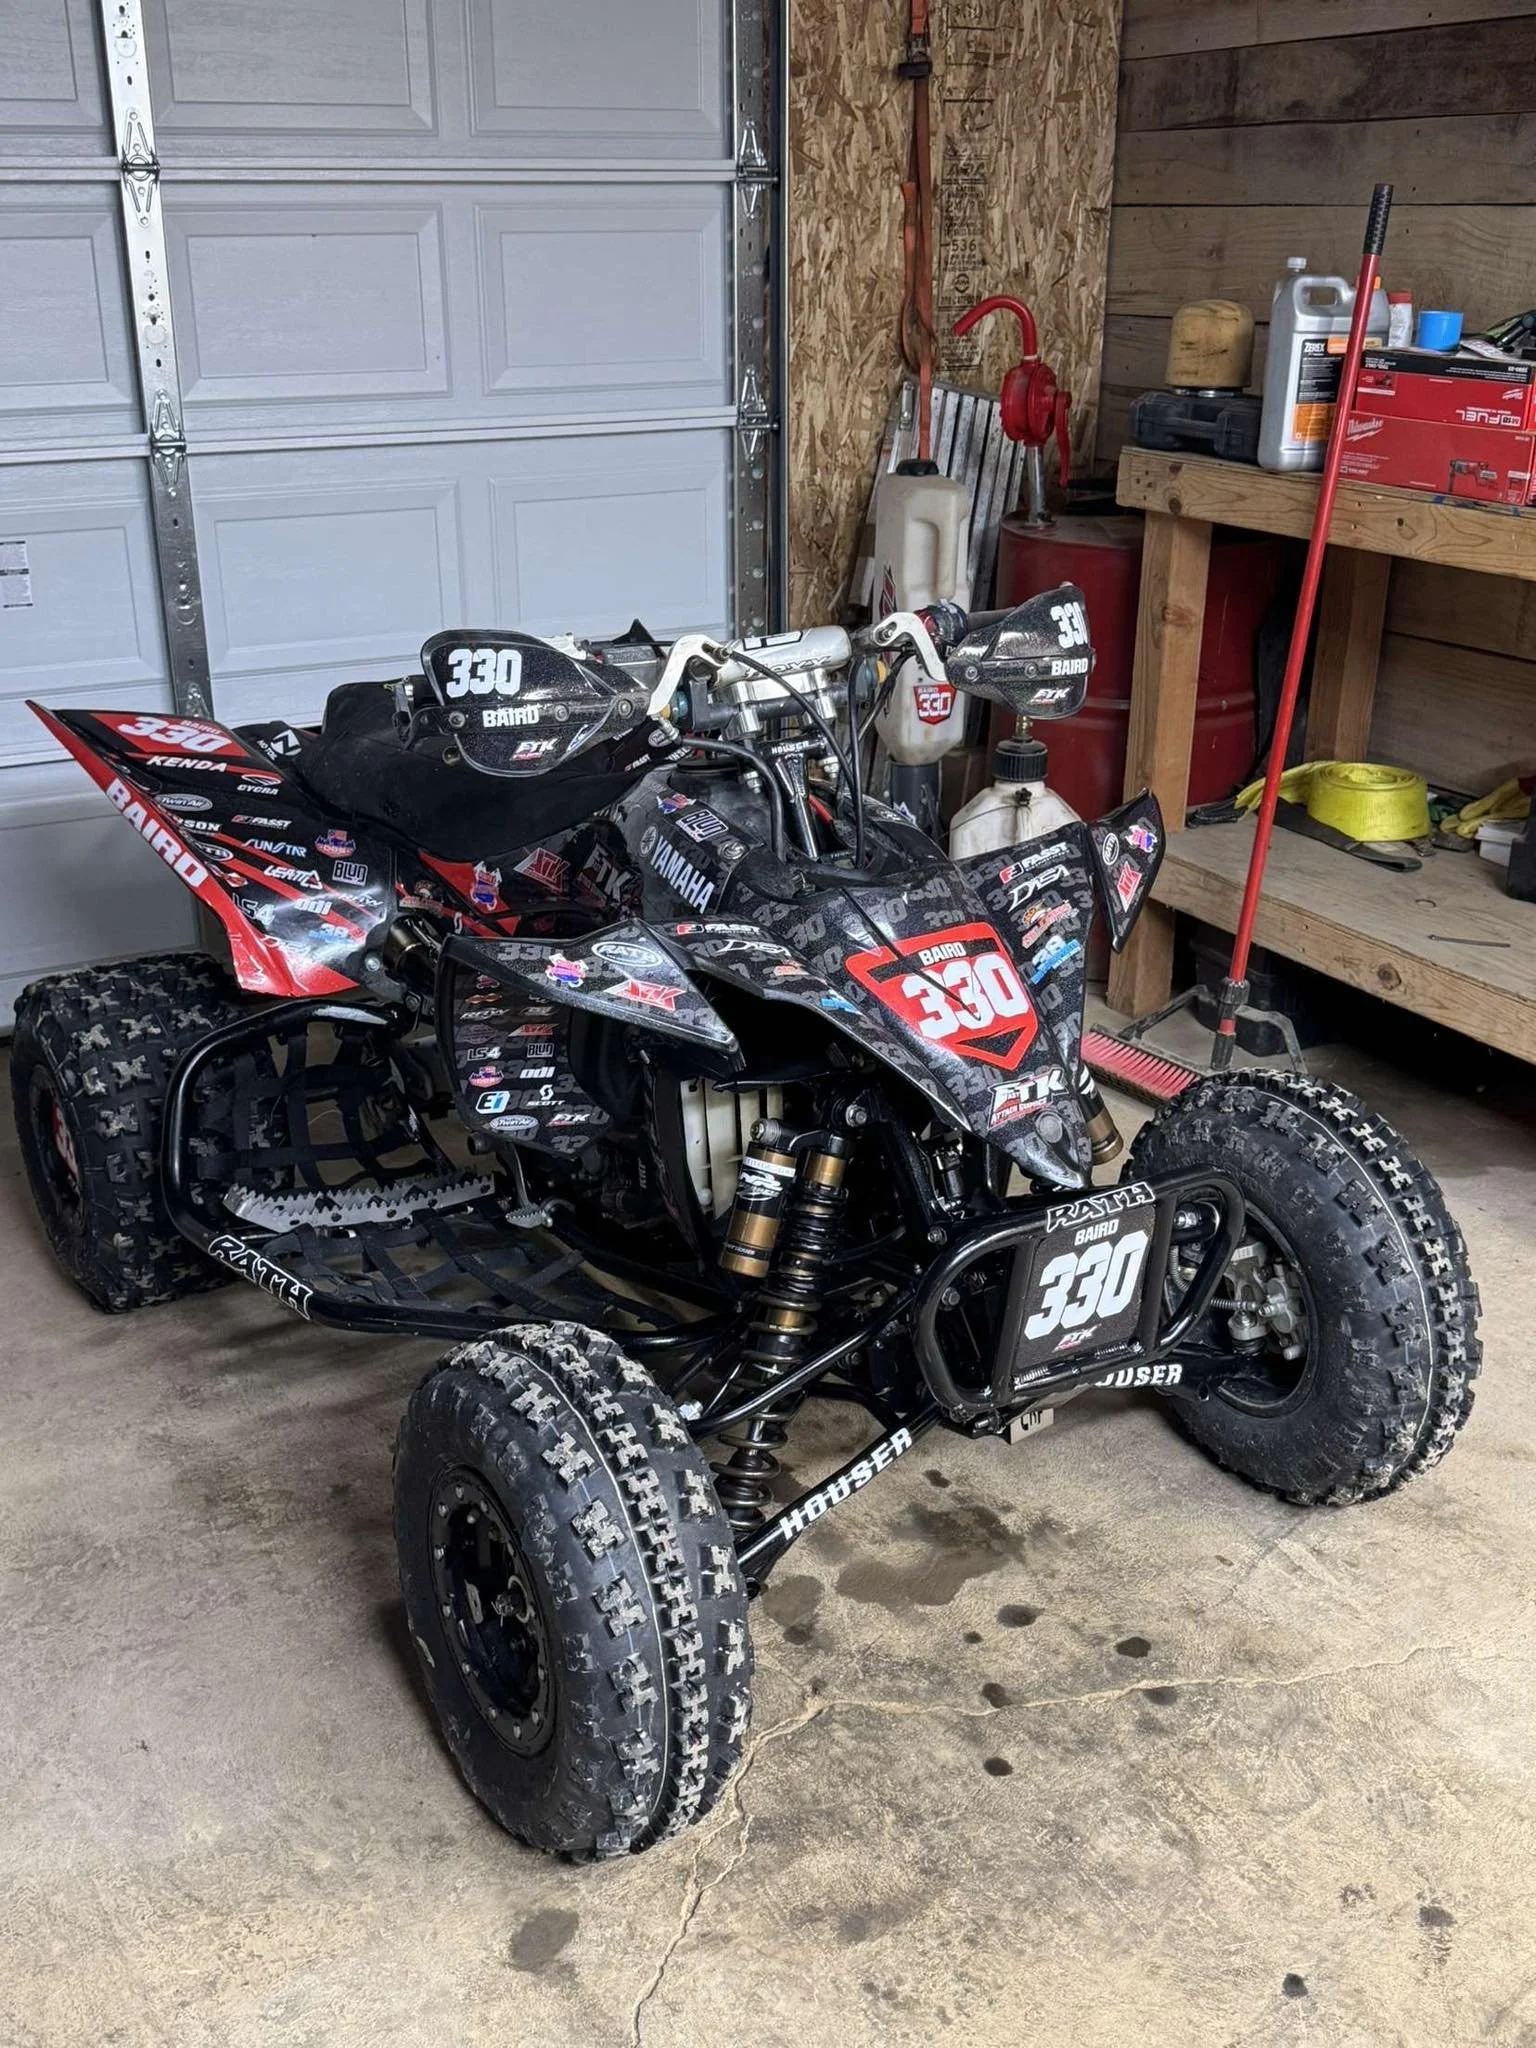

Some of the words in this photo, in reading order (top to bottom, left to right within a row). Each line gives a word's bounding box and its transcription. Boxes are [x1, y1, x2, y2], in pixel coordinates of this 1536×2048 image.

[1304, 343, 1325, 353] ZEREX
[1456, 408, 1498, 424] FUEL
[446, 648, 522, 698] 330
[1051, 658, 1088, 676] BAIRD
[482, 704, 540, 728] BAIRD
[918, 692, 952, 717] 330
[117, 716, 232, 752] 330
[146, 755, 228, 773] KENDA
[236, 784, 279, 795] CYCRA
[105, 779, 208, 887] BAIRD
[252, 816, 292, 828] FASST
[1021, 842, 1068, 868] FASST
[650, 835, 715, 914] YAMAHA
[705, 923, 760, 936] FASST
[918, 941, 967, 967] BAIRD
[901, 953, 1030, 1040] 330
[1046, 1182, 1156, 1233] RATH
[1074, 1218, 1119, 1246] BAIRD
[208, 1235, 314, 1321] RATH
[1024, 1230, 1149, 1340] 330
[779, 1427, 913, 1541] HOUSER
